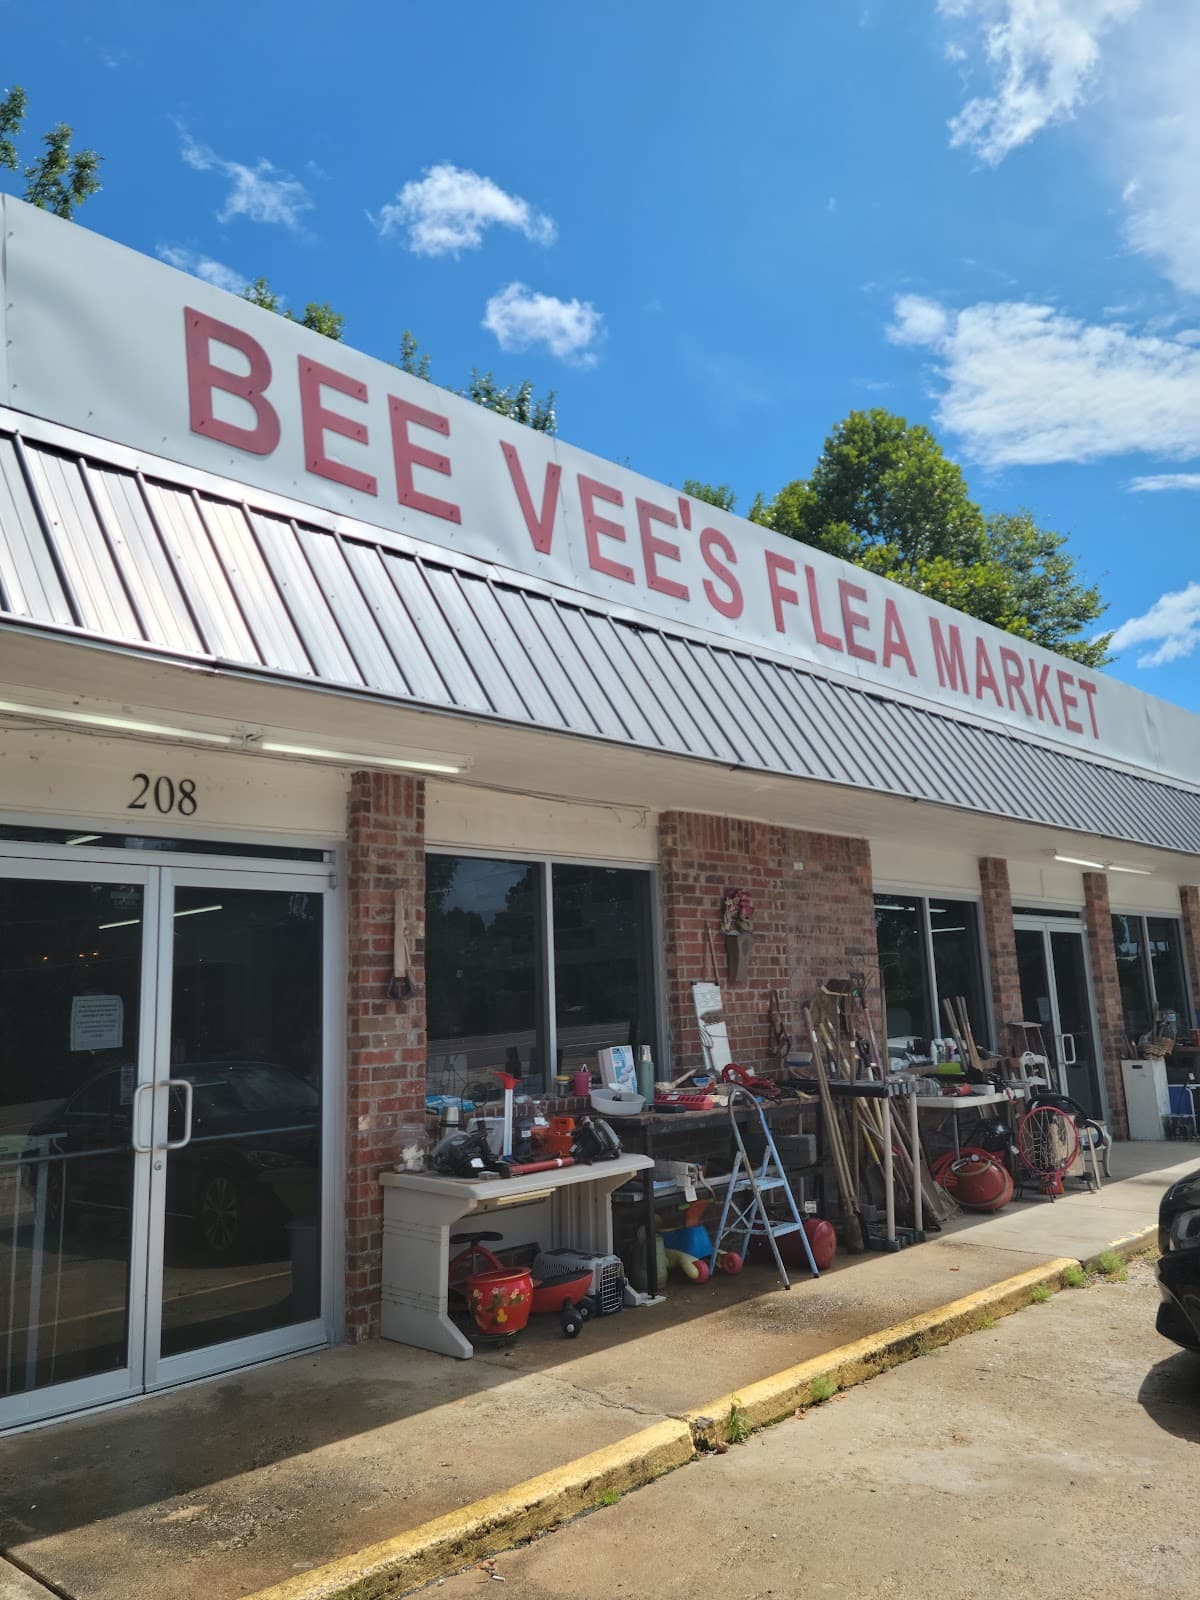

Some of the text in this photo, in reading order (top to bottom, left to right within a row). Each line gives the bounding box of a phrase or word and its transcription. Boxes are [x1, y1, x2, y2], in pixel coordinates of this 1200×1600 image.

[184, 306, 1098, 739] BEE VEE'S FLEA MARKET
[127, 773, 198, 816] 208
